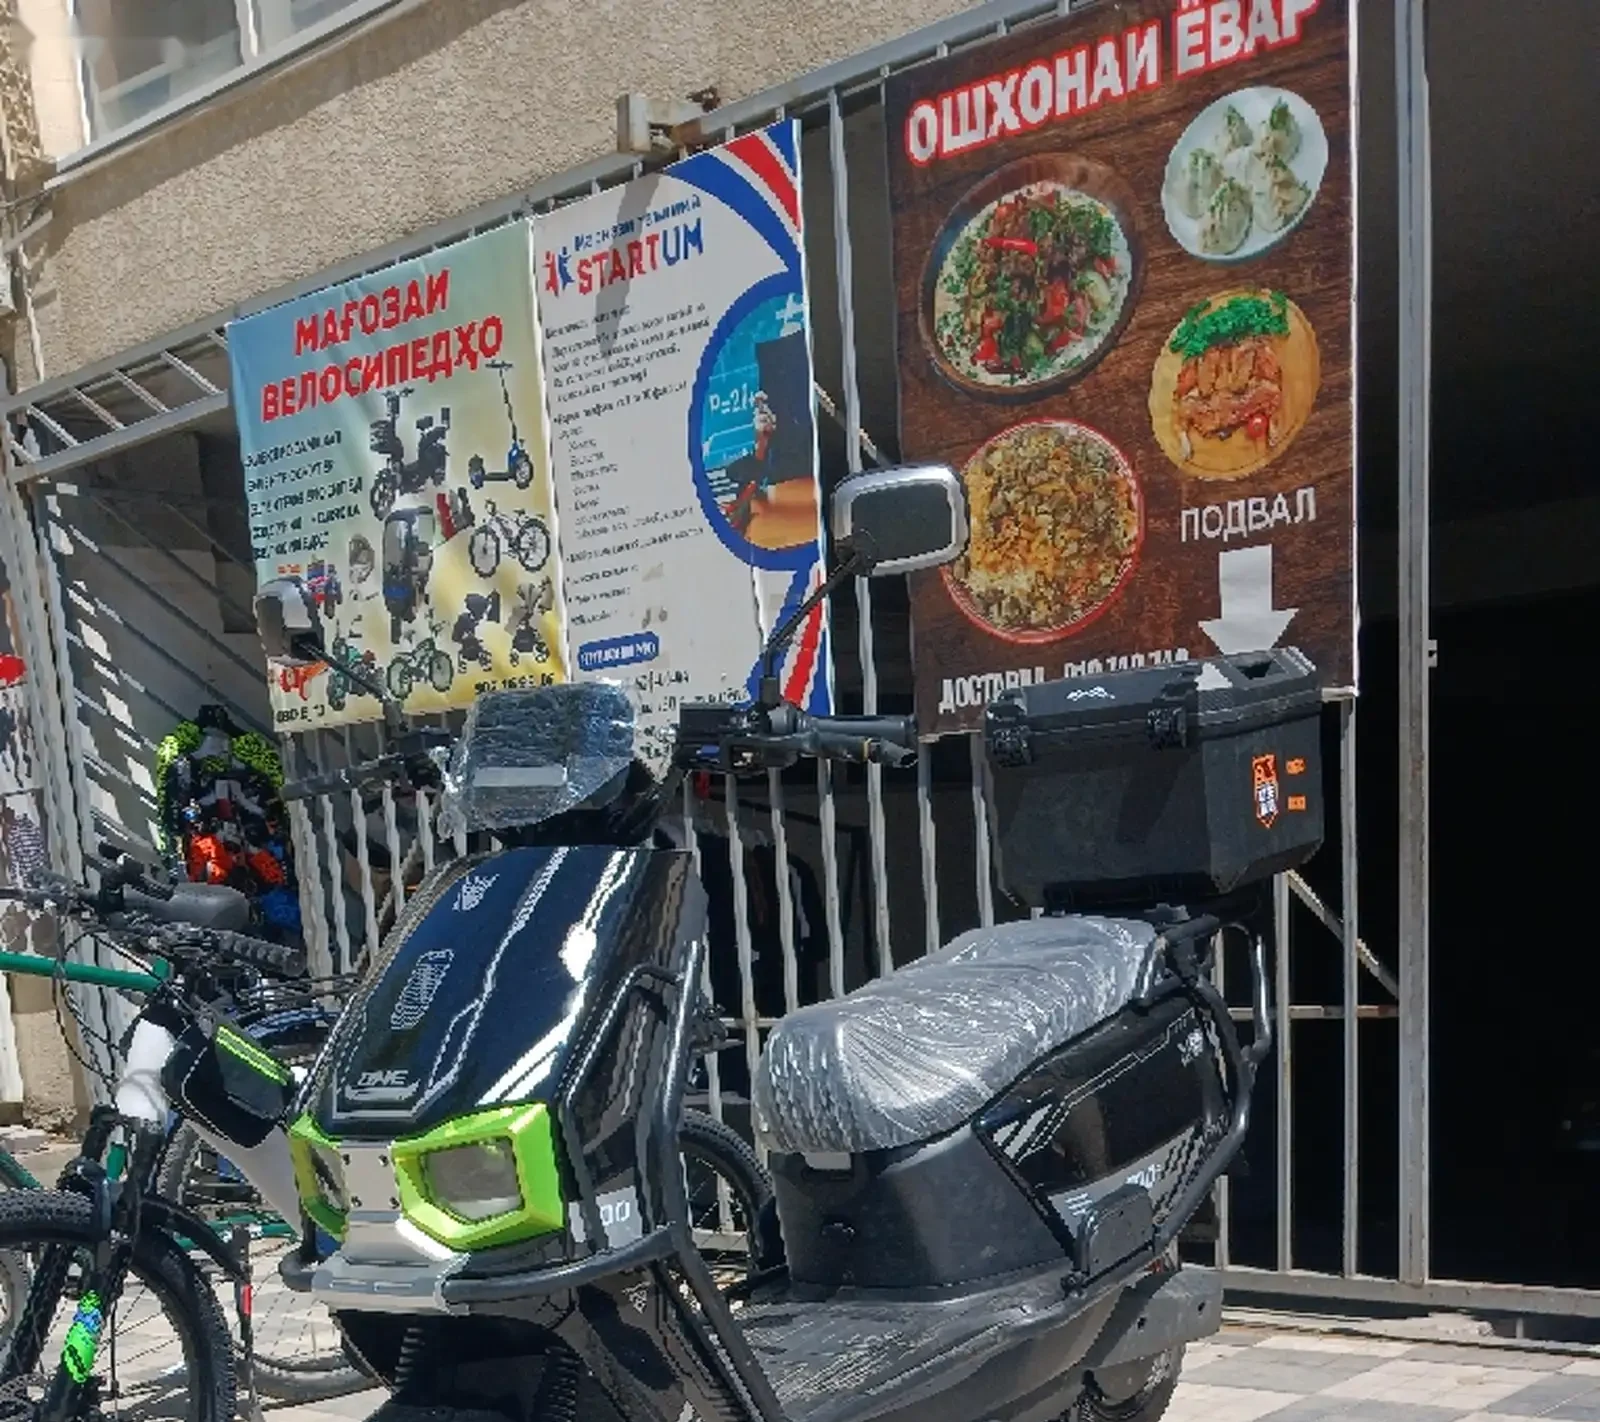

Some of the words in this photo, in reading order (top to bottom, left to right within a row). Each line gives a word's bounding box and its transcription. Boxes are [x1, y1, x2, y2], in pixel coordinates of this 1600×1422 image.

[906, 23, 1162, 164] ОШХОНАИ
[1175, 0, 1317, 77] ЁВАР
[577, 217, 704, 296] STARTUM
[261, 315, 503, 423] ВЕЛОСИПЕДҲО
[1181, 486, 1318, 543] ПОДВАЛ
